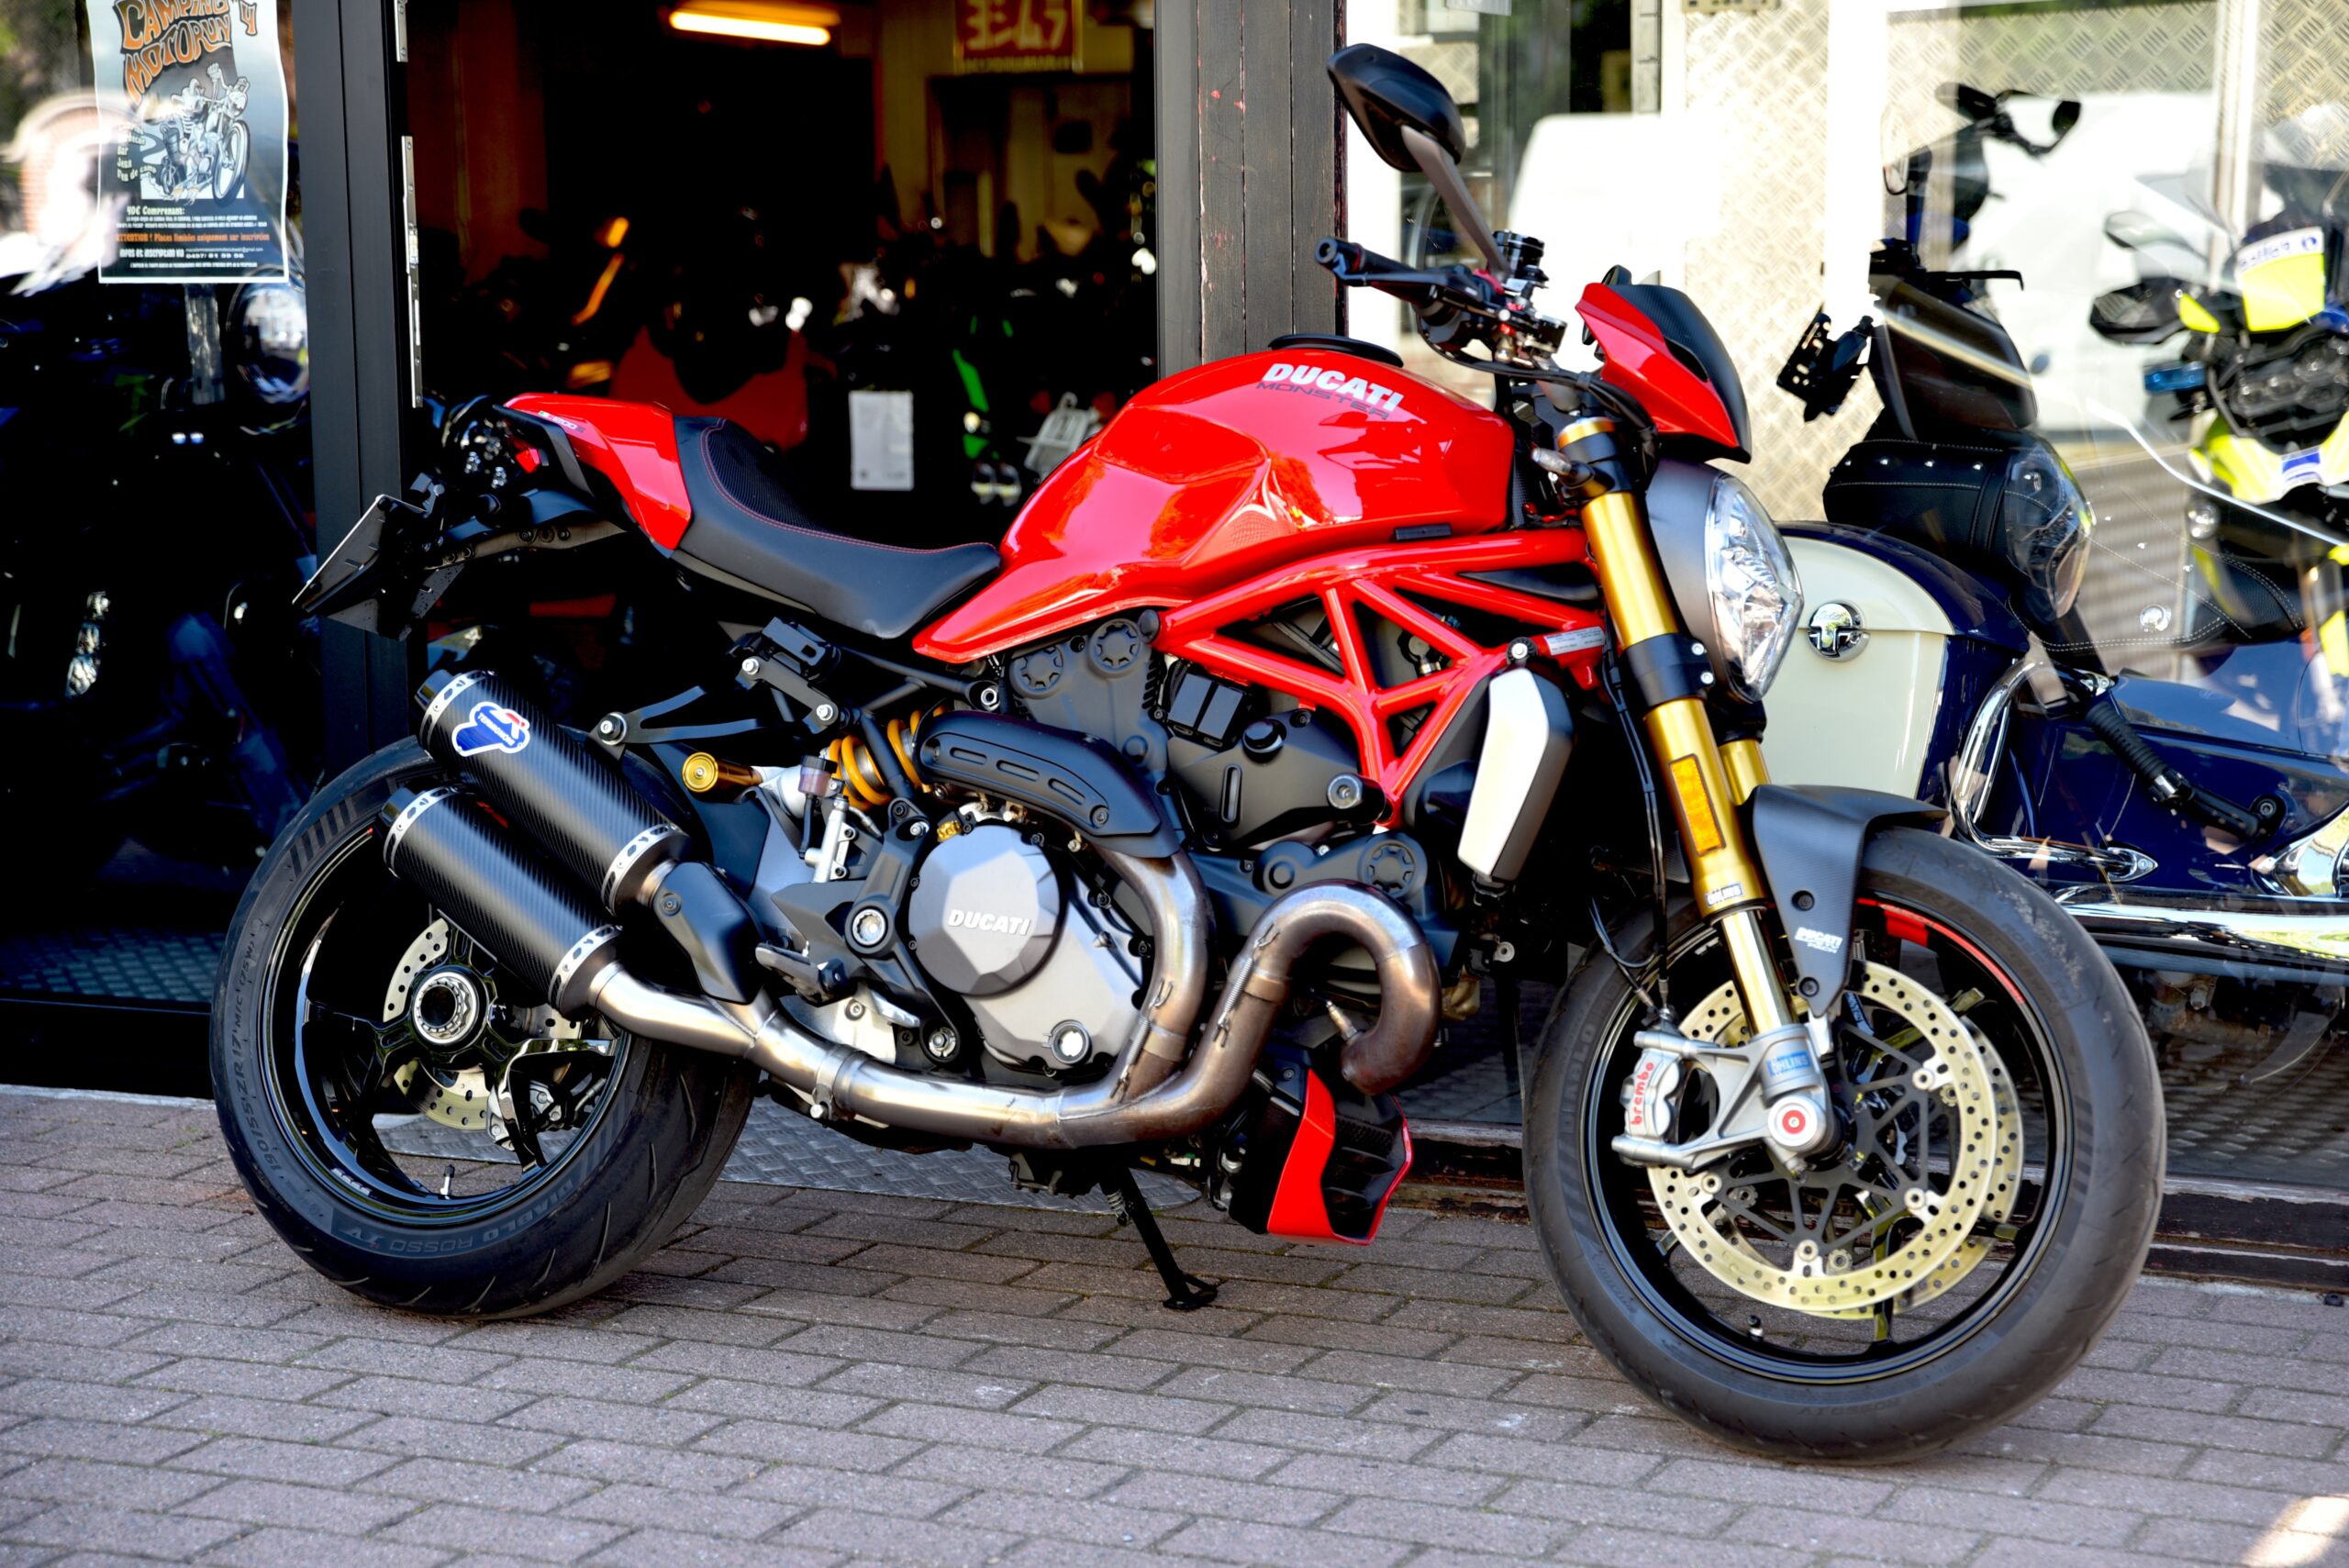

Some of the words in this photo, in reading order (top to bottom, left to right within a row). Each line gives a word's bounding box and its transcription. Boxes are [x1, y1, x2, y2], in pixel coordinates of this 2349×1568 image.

[116, 0, 230, 50] CAMPING
[124, 15, 232, 107] MOTORUN
[1256, 383, 1390, 420] MONSTER
[1262, 363, 1404, 411] DUCATI
[947, 909, 1030, 936] DUCATI
[1630, 1062, 1654, 1125] brembo
[484, 1178, 574, 1241] DIABLO
[390, 1238, 473, 1253] ROSSO
